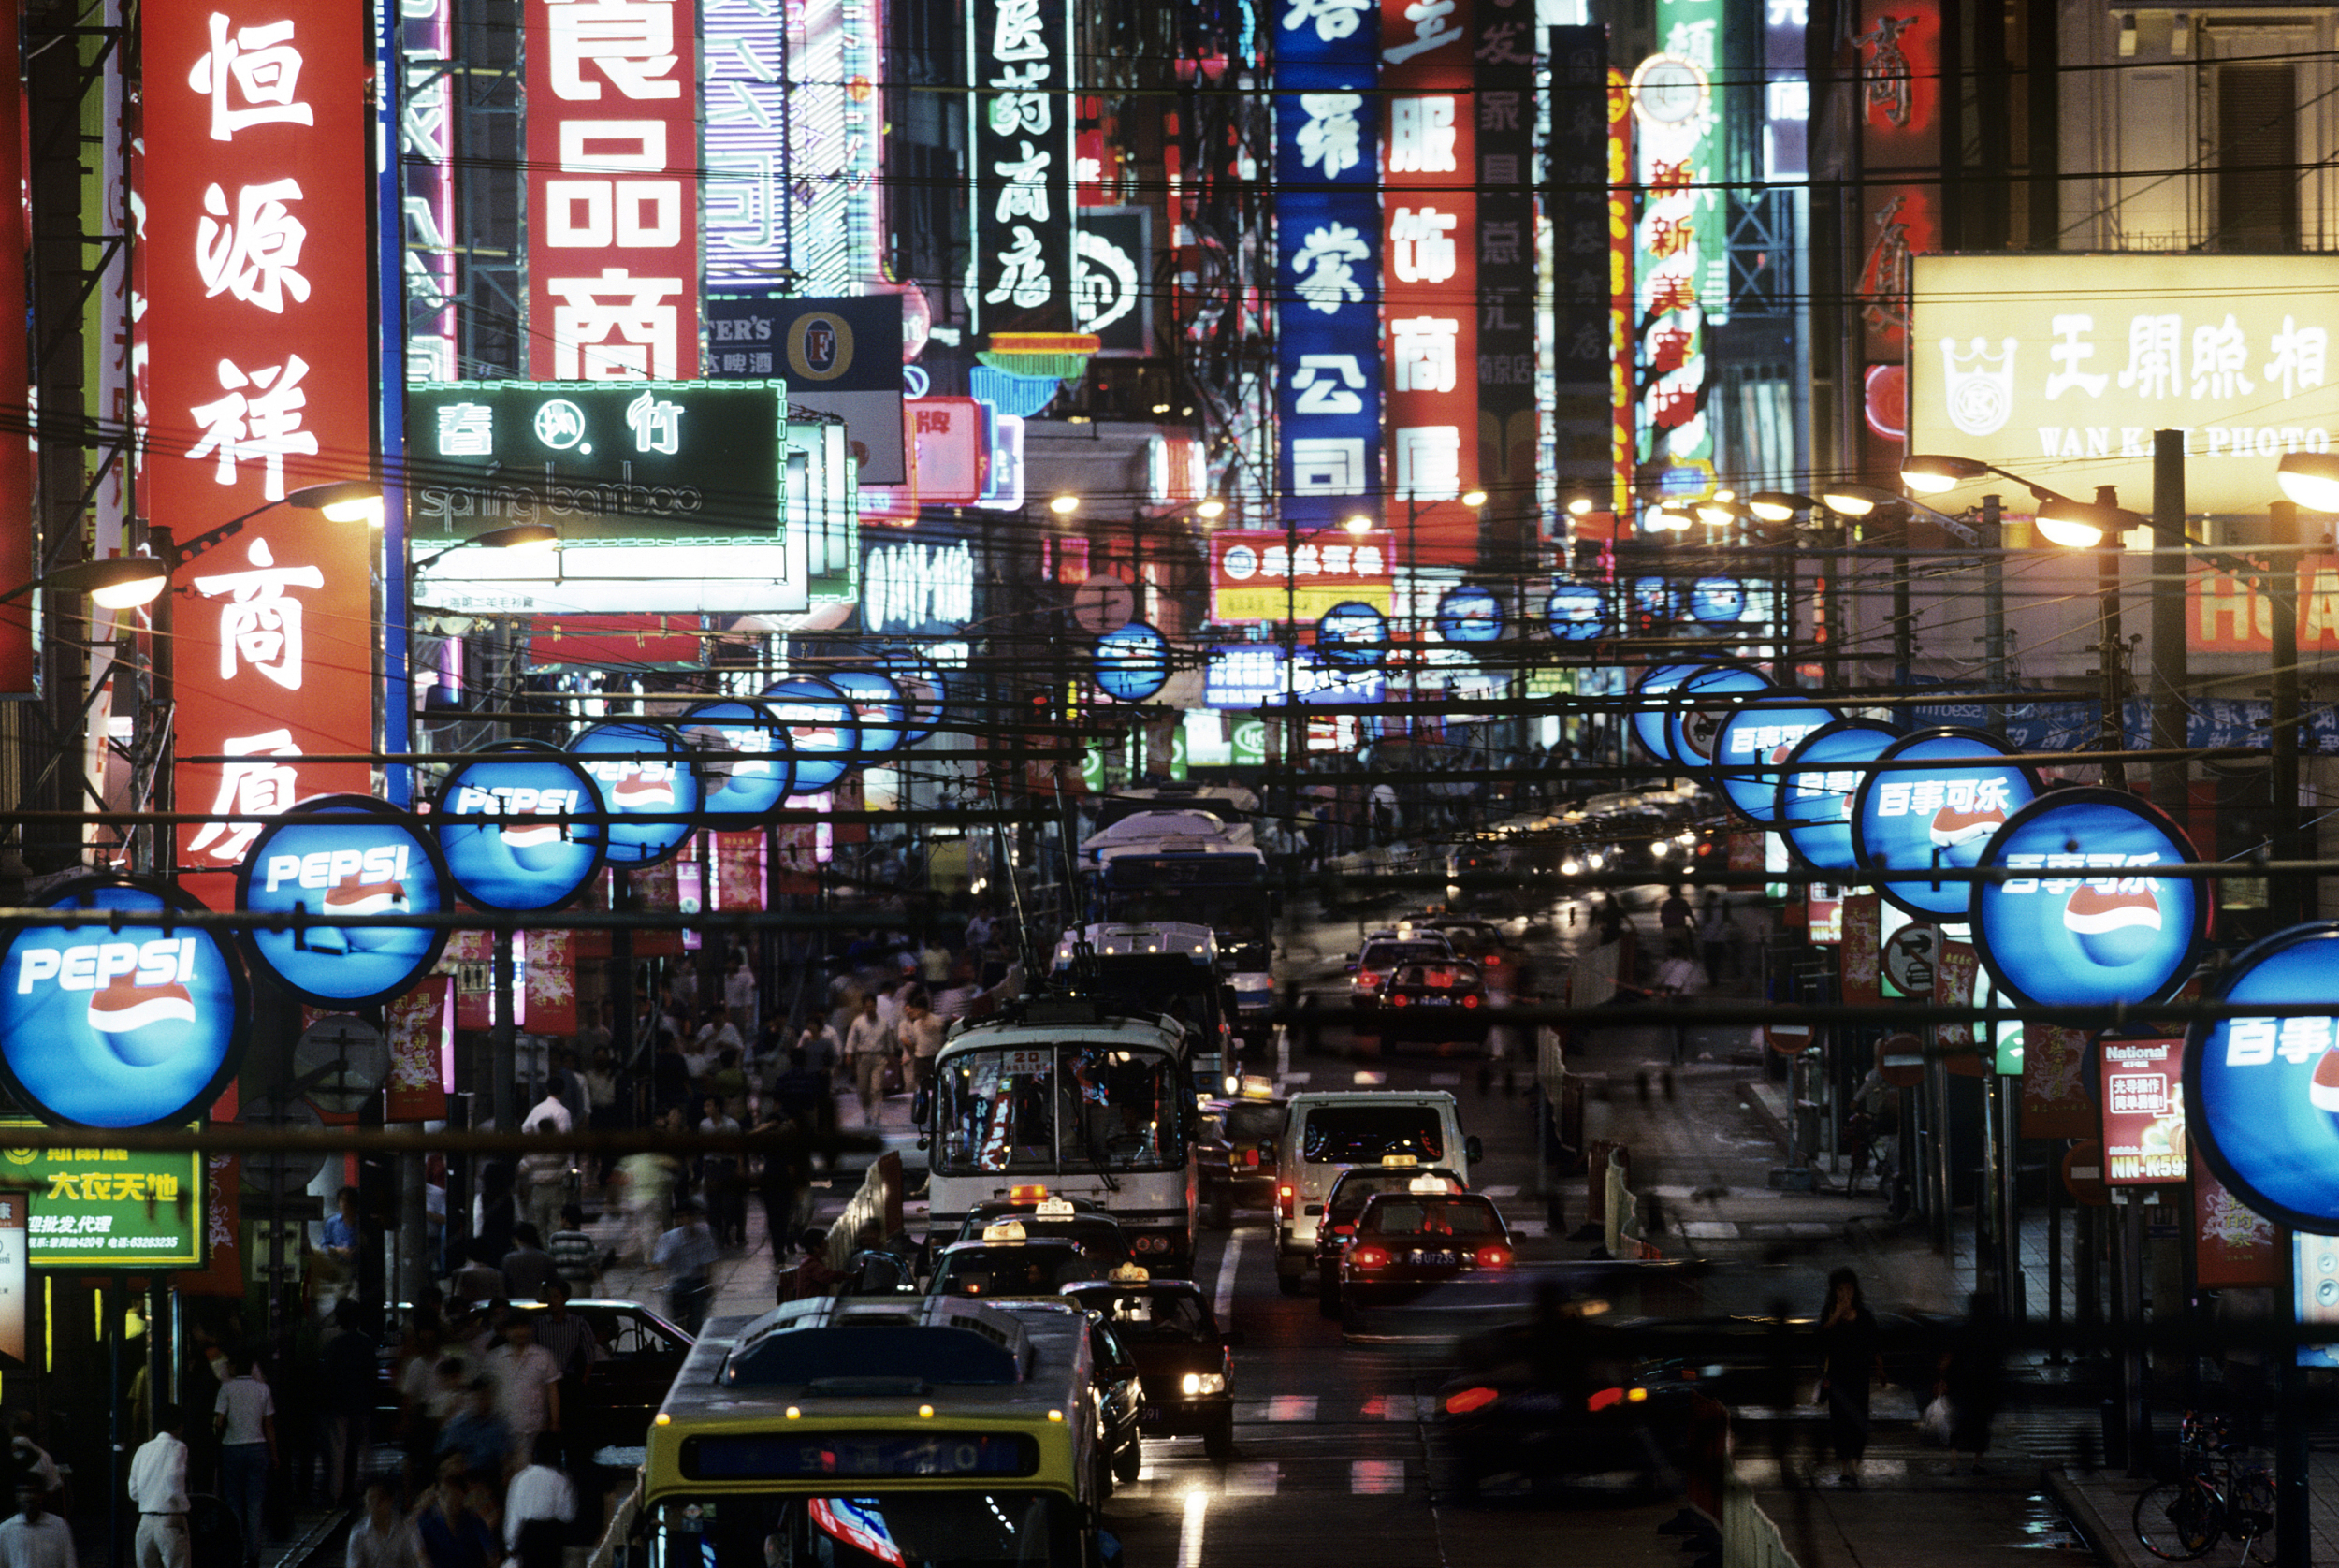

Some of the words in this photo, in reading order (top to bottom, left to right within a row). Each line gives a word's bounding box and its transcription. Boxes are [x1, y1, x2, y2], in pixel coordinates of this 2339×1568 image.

[1475, 0, 1536, 331] 发家具总汇
[2038, 426, 2110, 457] WAN
[2120, 426, 2197, 457] KI
[2205, 426, 2331, 457] PHOTO
[545, 460, 702, 516] bamboo
[456, 787, 579, 815] PEPSI
[1797, 771, 1866, 797] 百事
[1878, 777, 2011, 817] 百事可乐
[266, 845, 410, 893] PEPSI
[17, 937, 196, 995] PEPSI
[1014, 1052, 1039, 1063] 20
[2106, 1044, 2167, 1059] National
[2226, 1016, 2339, 1067] 百事
[47, 1171, 179, 1201] 大衣天地
